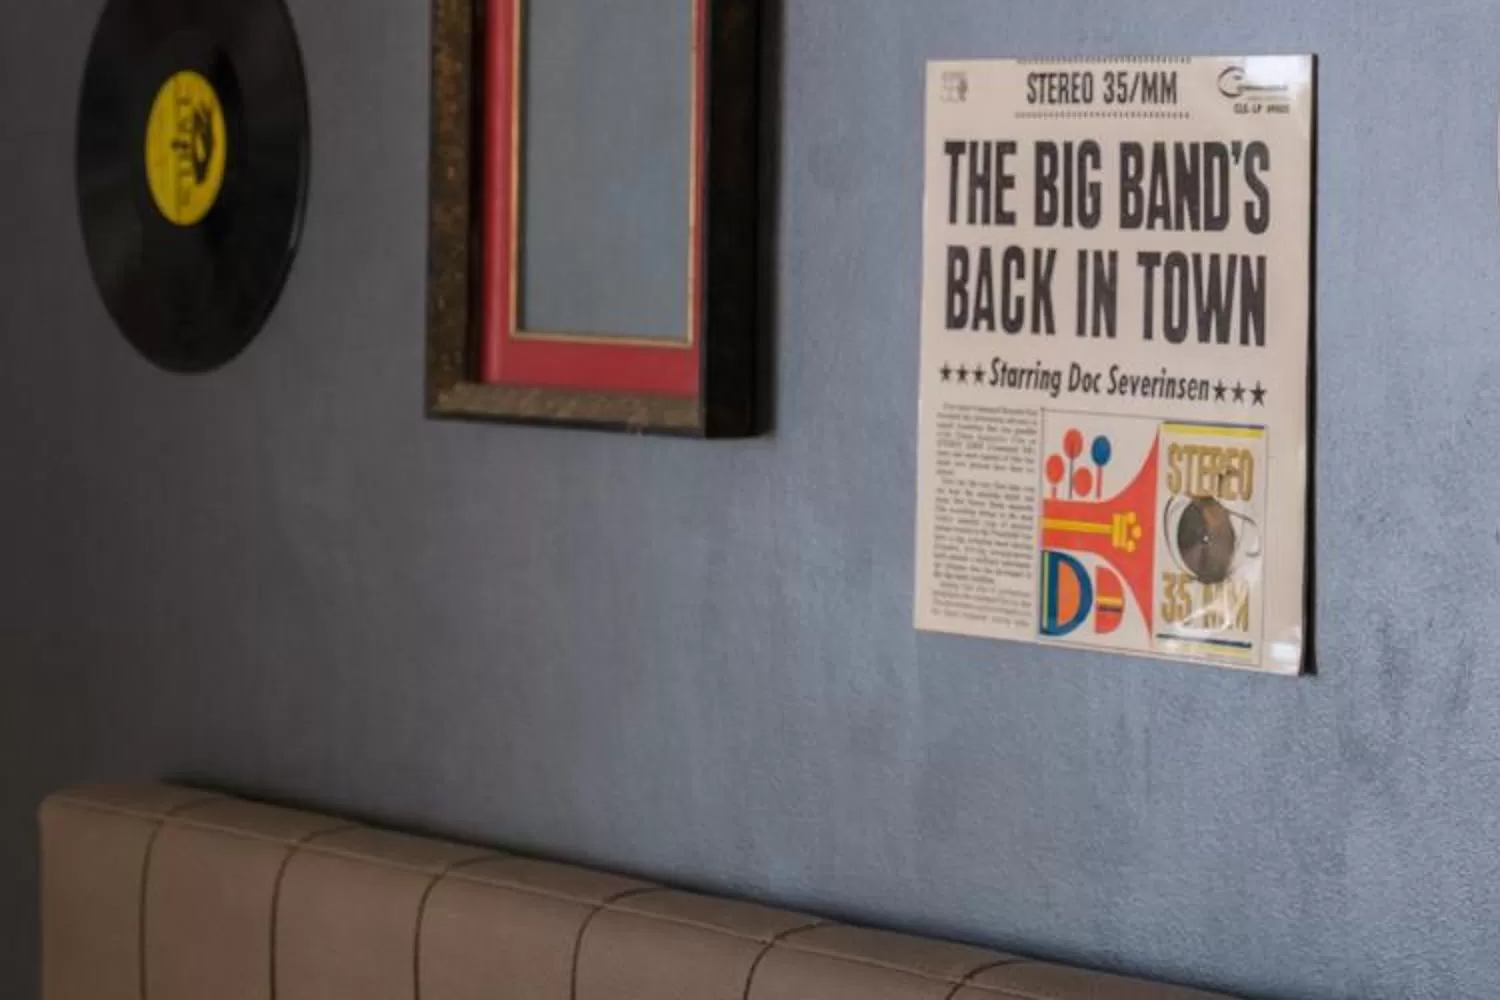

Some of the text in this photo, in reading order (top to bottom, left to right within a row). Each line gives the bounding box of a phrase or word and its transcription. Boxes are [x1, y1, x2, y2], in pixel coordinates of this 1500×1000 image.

[1026, 71, 1178, 105] STEREO 35/MM
[944, 139, 1271, 235] THE BIG BAND'S
[945, 245, 1267, 347] BACK IN TOWN
[989, 357, 1210, 402] Starring Doc Severinsen
[1166, 443, 1254, 501] STEREO
